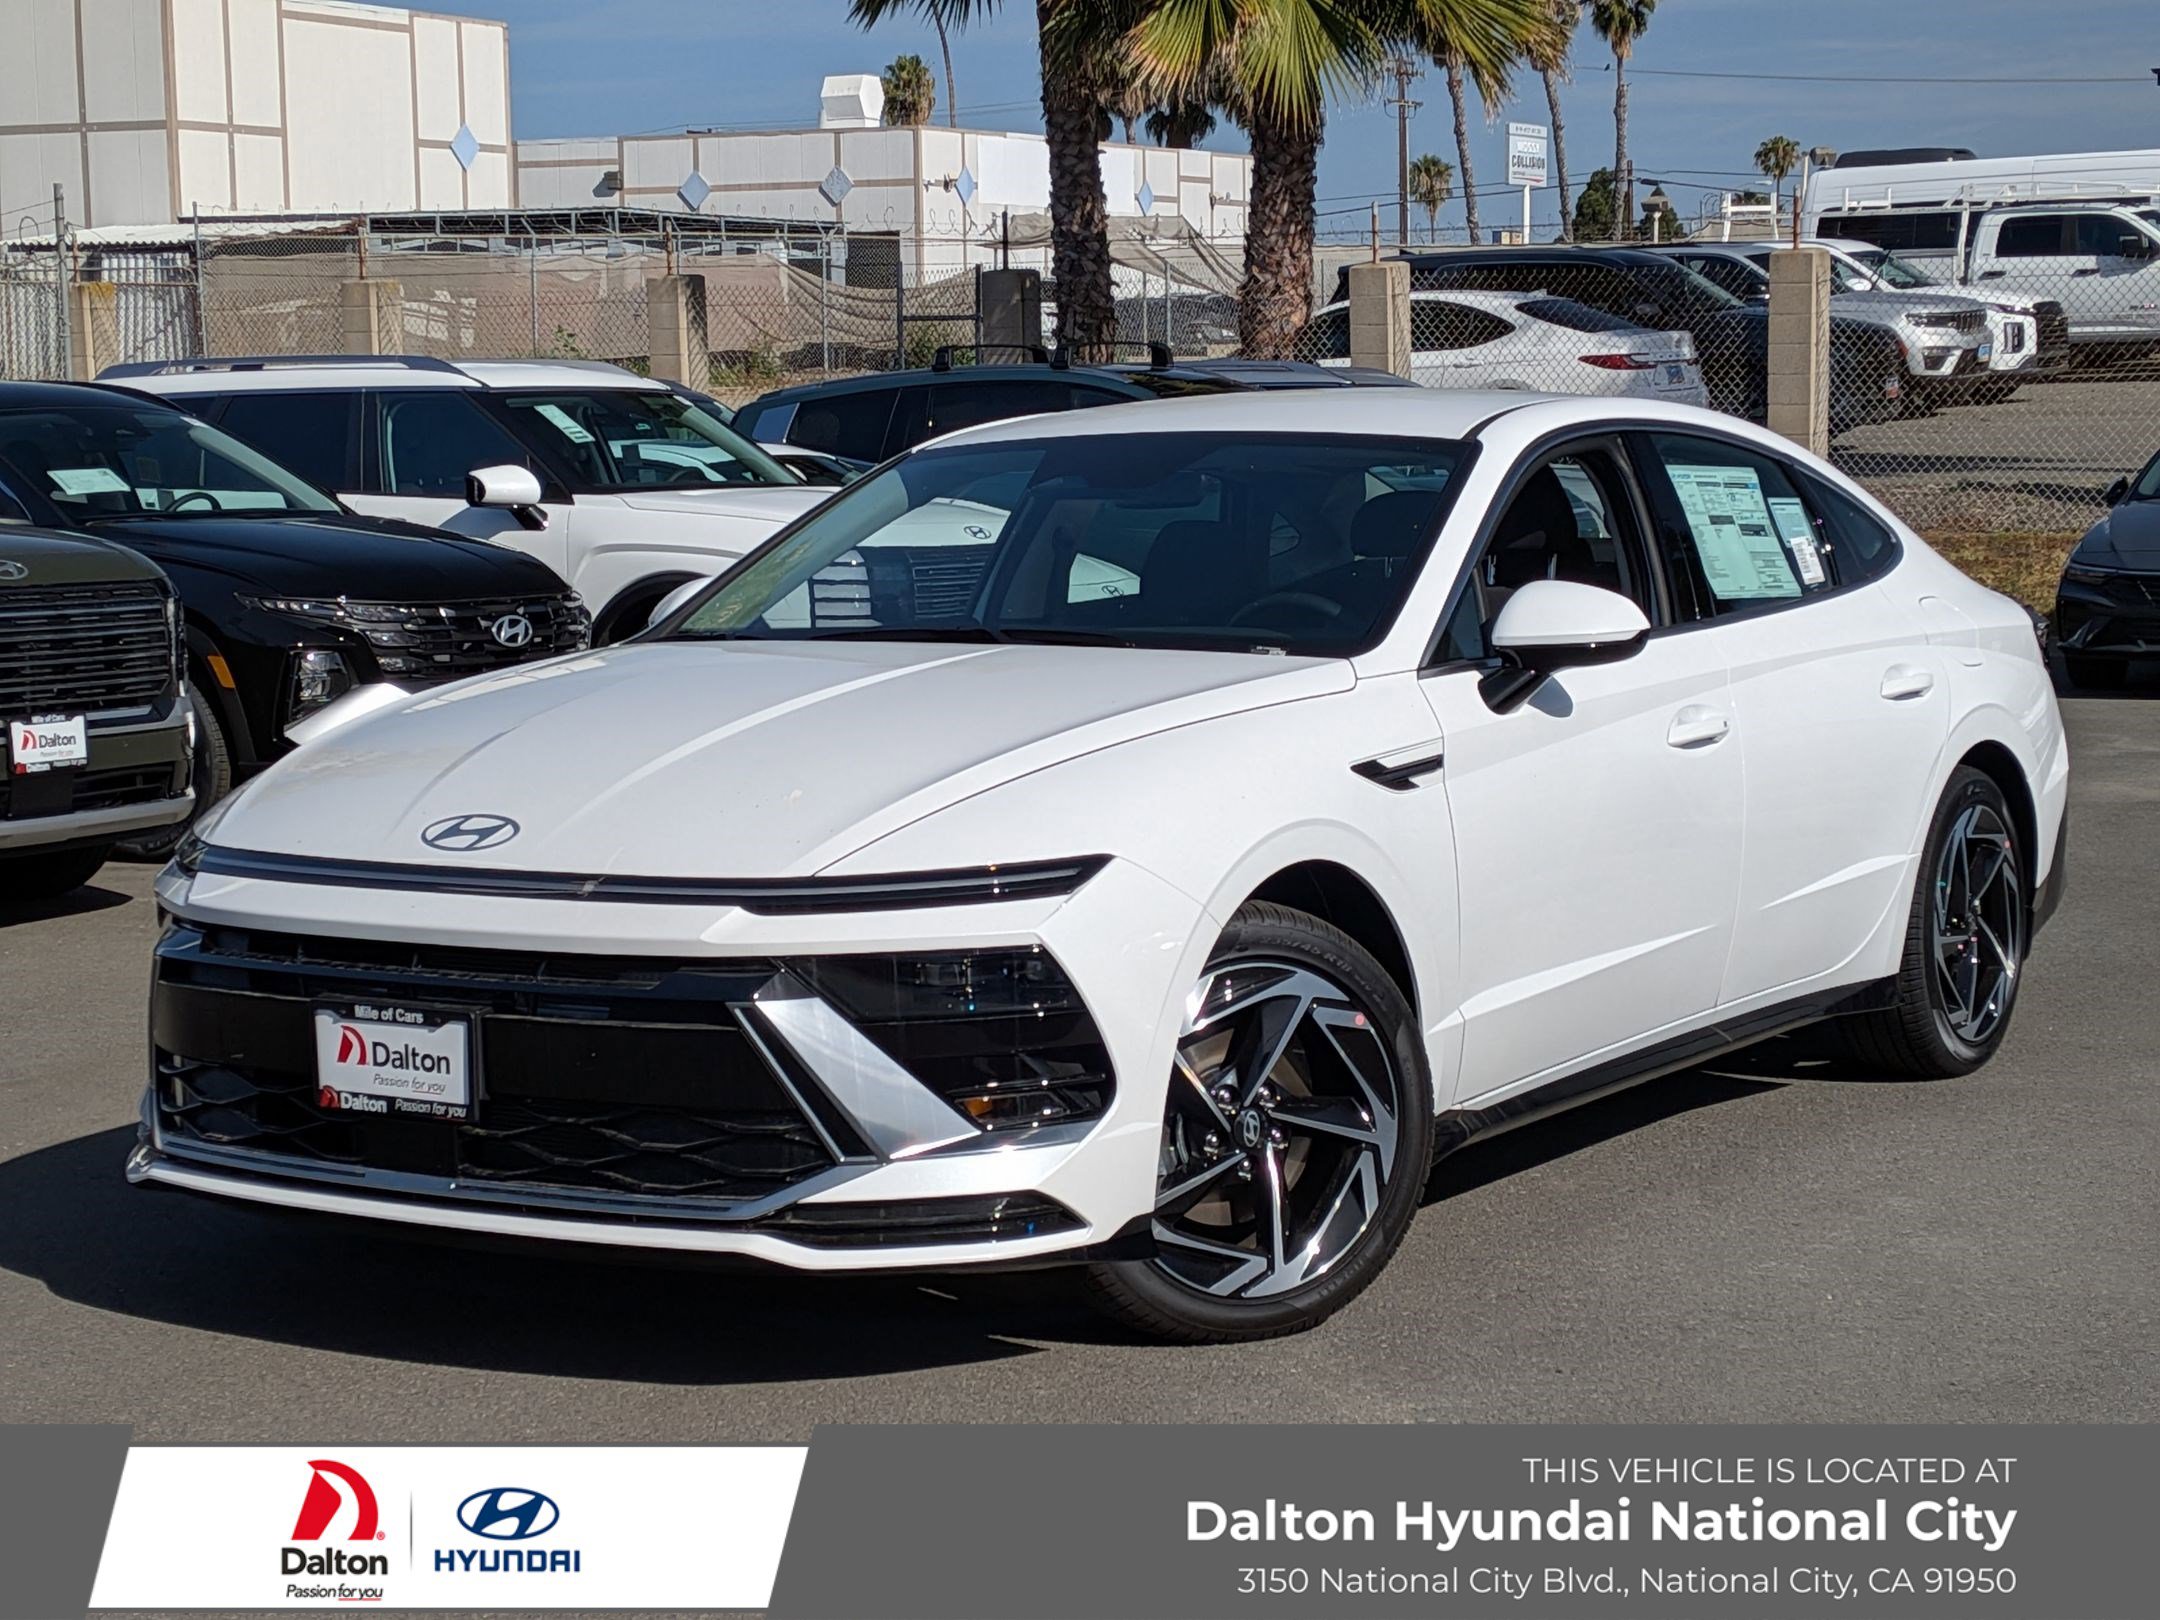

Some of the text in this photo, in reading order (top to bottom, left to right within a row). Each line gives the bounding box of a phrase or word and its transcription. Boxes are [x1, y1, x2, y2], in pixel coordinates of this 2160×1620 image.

[1511, 154, 1545, 170] COLLISION
[38, 733, 77, 749] Dalton
[354, 1004, 424, 1024] Mile of Cars
[371, 1041, 451, 1075] Dalton
[373, 1073, 447, 1094] Passion for you
[340, 1093, 388, 1113] Dalton
[394, 1099, 467, 1118] Passion for you
